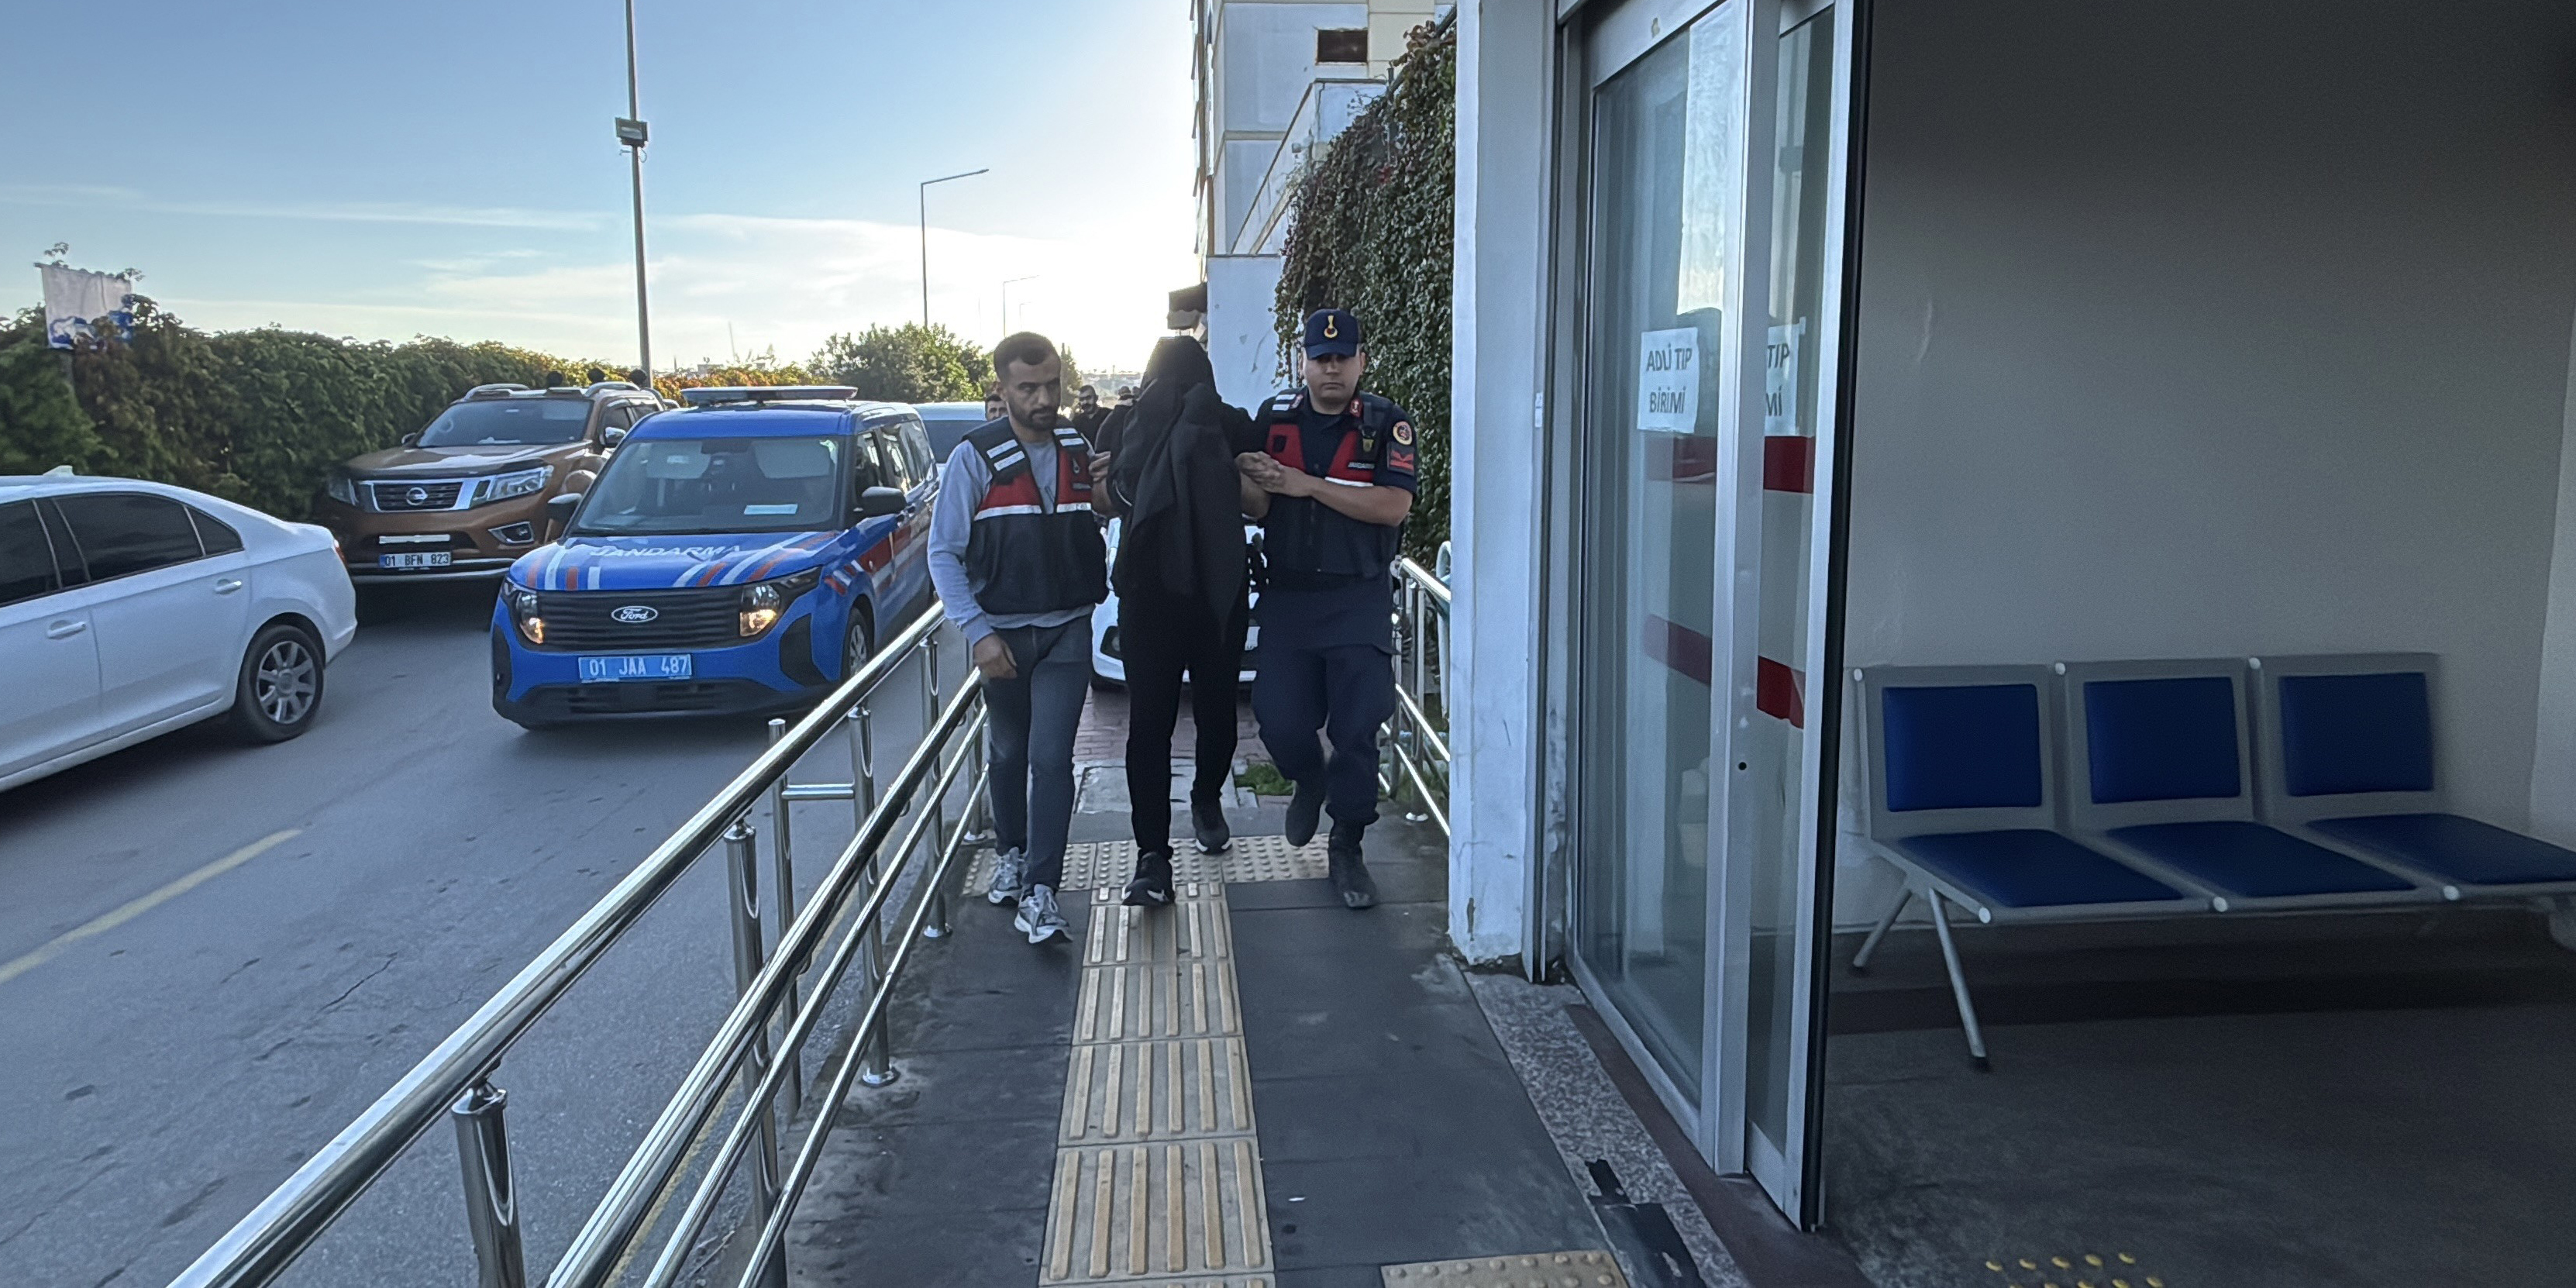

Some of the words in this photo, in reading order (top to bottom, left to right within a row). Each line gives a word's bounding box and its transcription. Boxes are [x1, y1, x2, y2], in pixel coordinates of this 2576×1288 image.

[1646, 343, 1672, 371] ADLİ
[1675, 348, 1693, 370] TIP
[1768, 343, 1790, 369] TIP
[1649, 386, 1686, 414] BİRİMİ
[385, 556, 396, 567] 01
[405, 554, 423, 566] BFN
[431, 553, 449, 564] 823
[590, 546, 740, 557] JANDARMA
[621, 608, 648, 620] Ford
[589, 659, 606, 676] 01
[618, 658, 646, 676] JAA
[661, 657, 687, 674] 487
